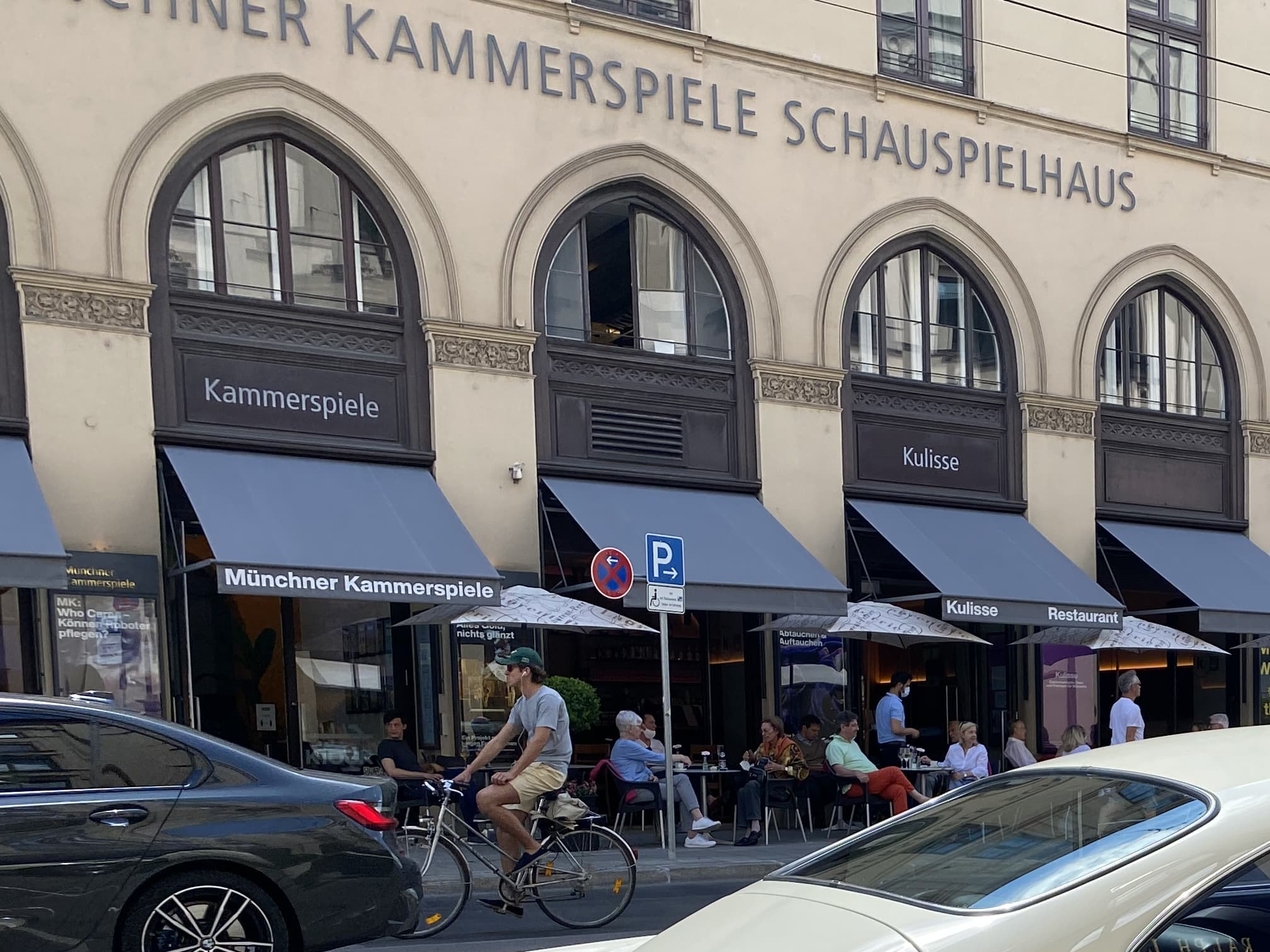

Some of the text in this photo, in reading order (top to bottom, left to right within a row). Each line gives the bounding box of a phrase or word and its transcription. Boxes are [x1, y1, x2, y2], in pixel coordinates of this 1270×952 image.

[344, 3, 758, 137] KAMMERSPIELE
[784, 100, 1137, 212] SCHAUSPIELHAUS
[203, 376, 379, 420] Kammerspiele
[902, 446, 960, 472] Kulisse
[652, 541, 673, 577] P
[224, 567, 494, 600] Münchner Kammerspiele
[57, 597, 82, 608] MK:
[57, 608, 85, 618] Who
[946, 600, 1119, 624] Kulisse Restaurant
[58, 630, 109, 641] pflegen?
[456, 630, 485, 639] nichts
[780, 638, 823, 647] Auftauchen
